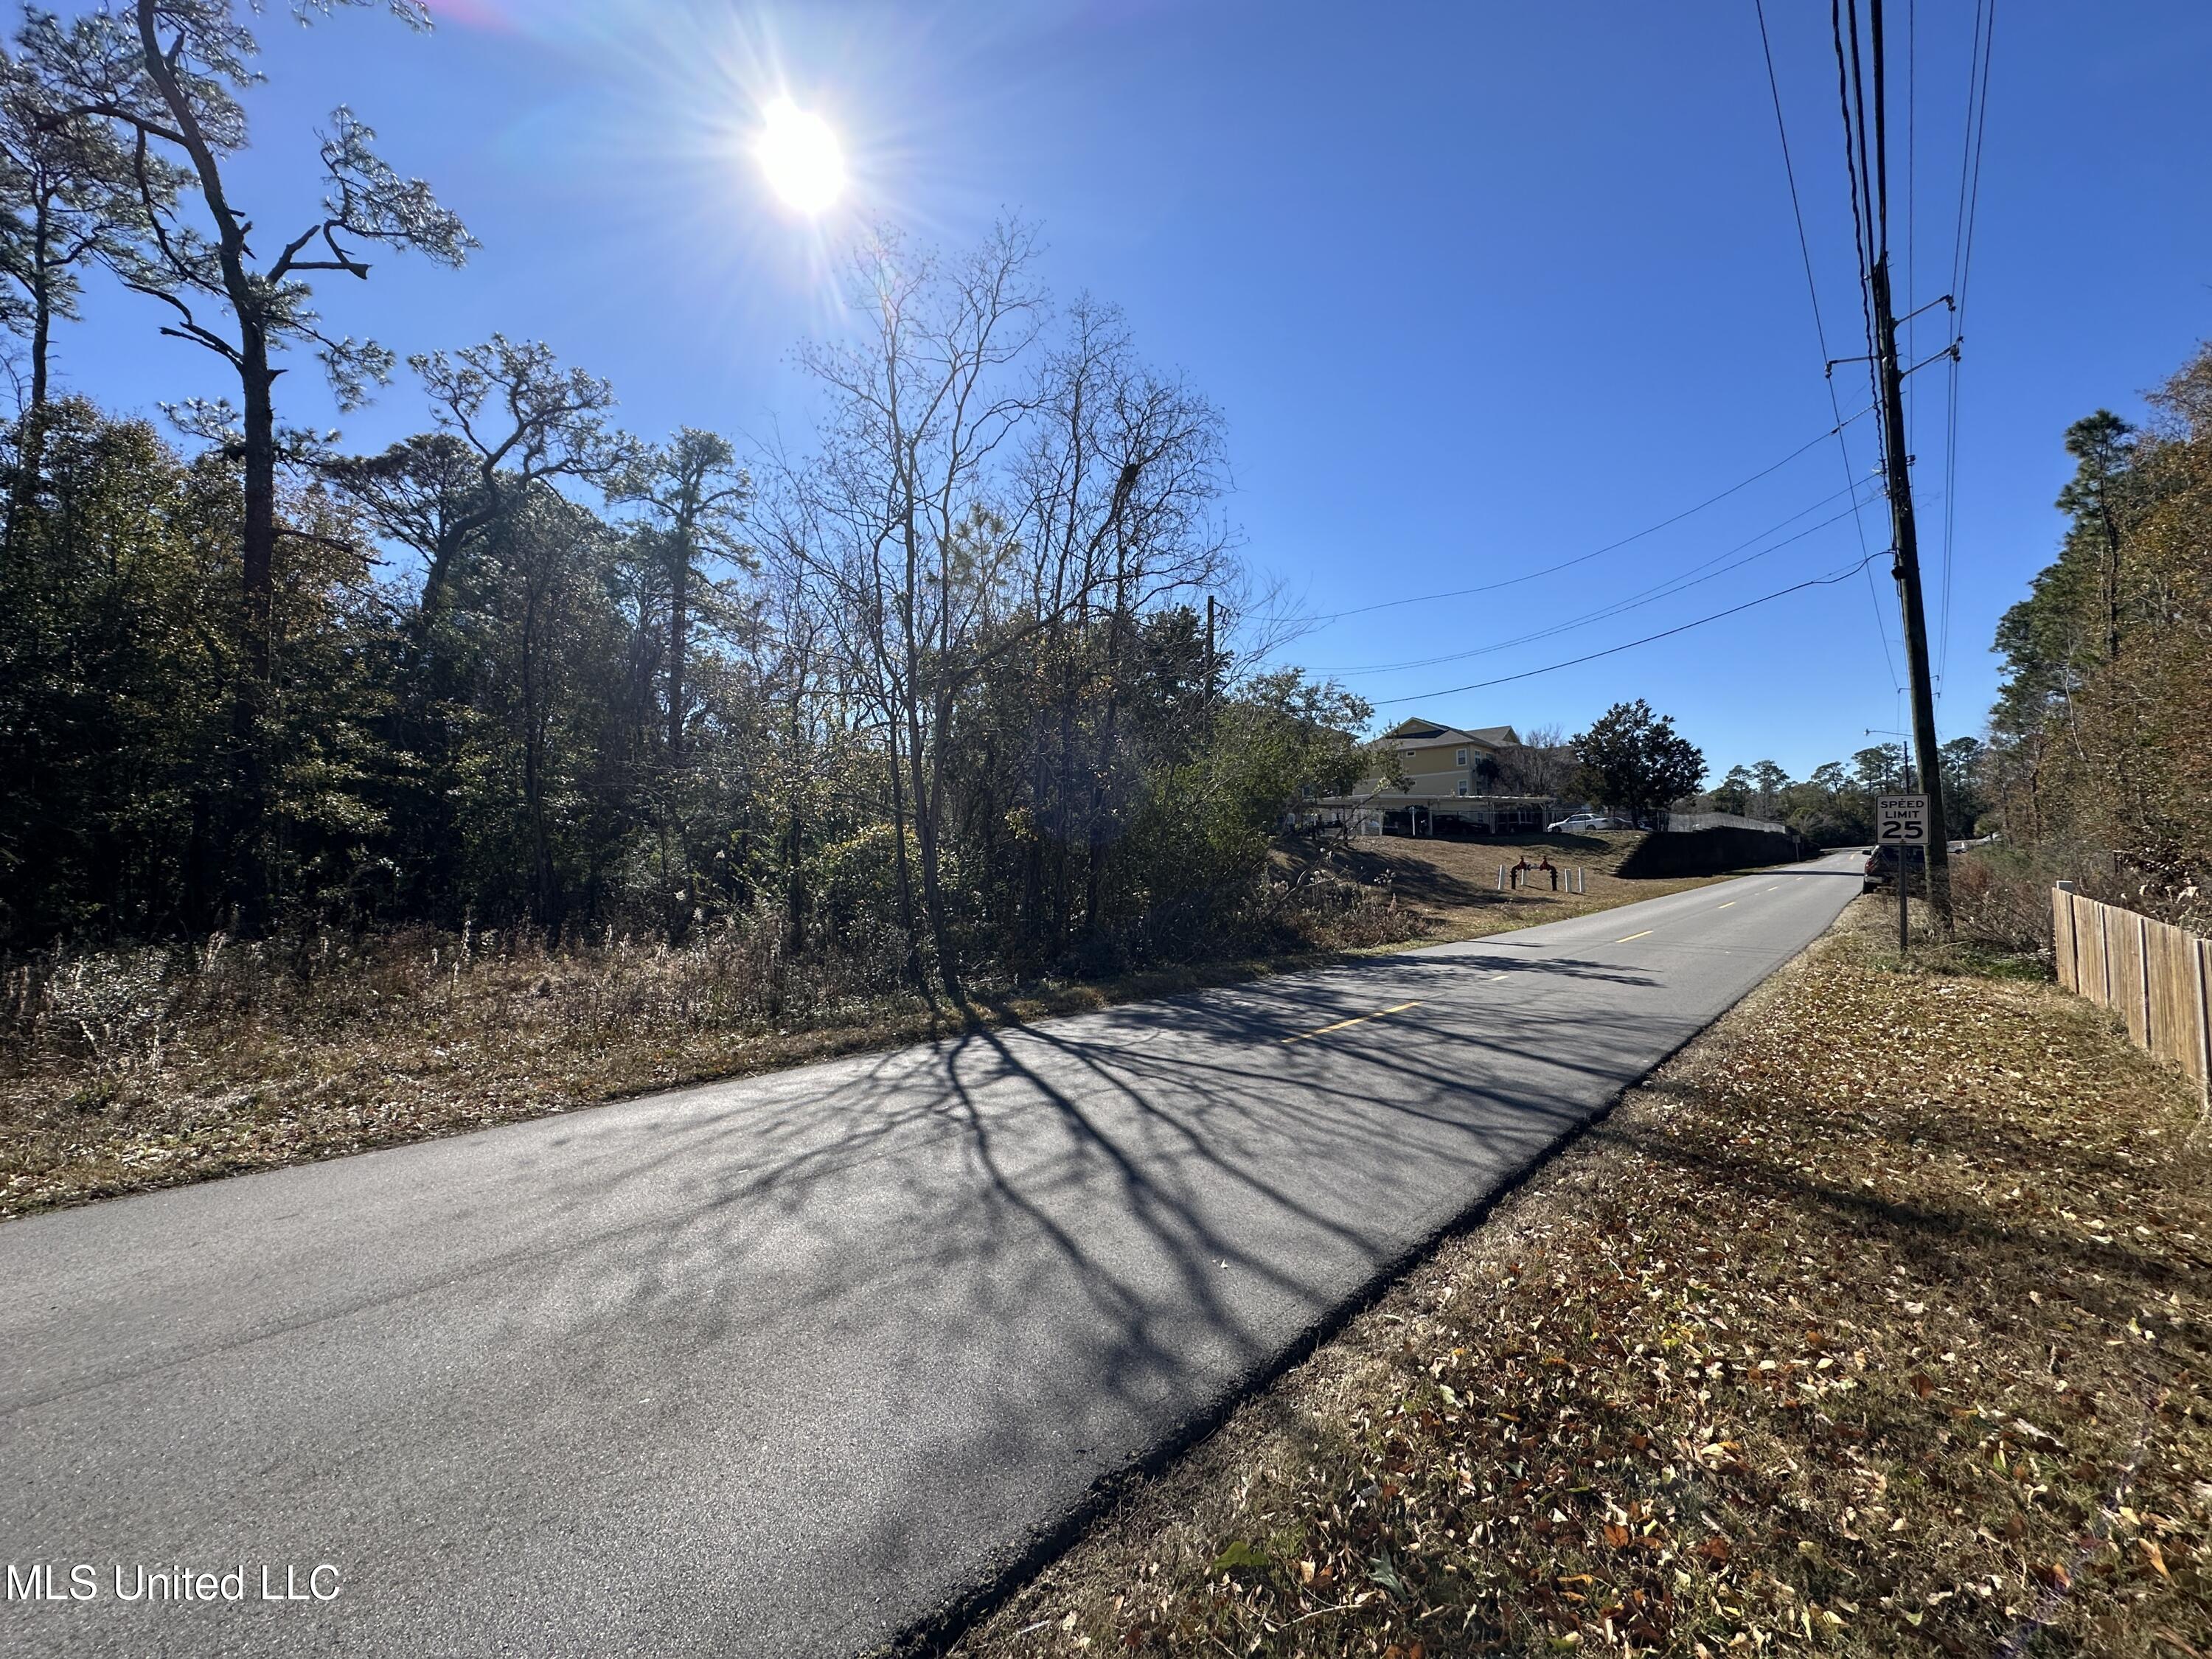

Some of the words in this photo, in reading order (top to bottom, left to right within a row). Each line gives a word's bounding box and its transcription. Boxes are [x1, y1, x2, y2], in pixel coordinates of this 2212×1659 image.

[1880, 801, 1924, 809] SPEED
[1885, 810, 1920, 818] LIMIT
[1882, 821, 1924, 839] 25
